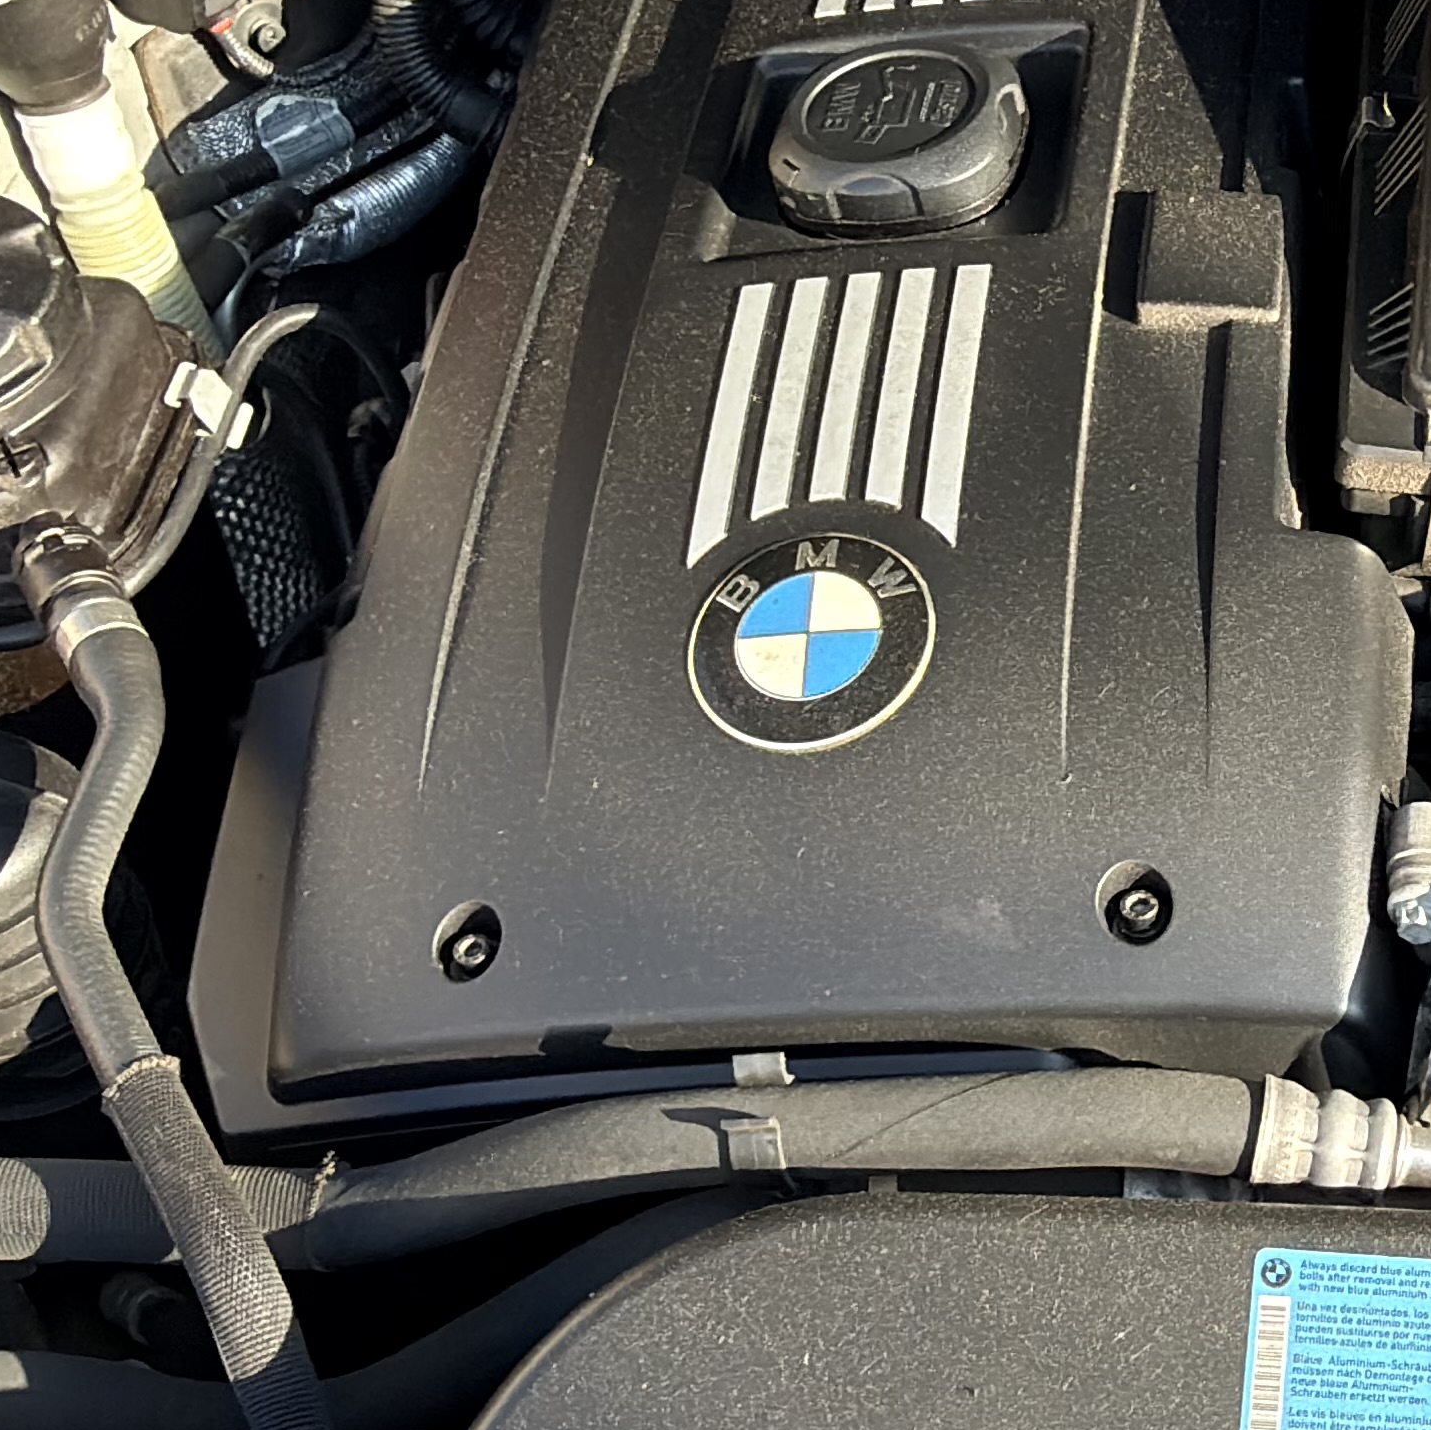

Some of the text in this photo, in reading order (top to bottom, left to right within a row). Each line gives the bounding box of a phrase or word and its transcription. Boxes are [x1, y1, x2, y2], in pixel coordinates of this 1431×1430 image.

[715, 538, 917, 613] BMW
[1300, 1259, 1337, 1274] Always
[1340, 1263, 1377, 1274] discard
[1380, 1265, 1401, 1276] blue
[1300, 1271, 1324, 1281] bolts
[1328, 1273, 1350, 1282] after
[1354, 1276, 1395, 1285] removal
[1398, 1279, 1417, 1288] and
[1299, 1283, 1320, 1292] with
[1348, 1285, 1369, 1295] blue
[1372, 1287, 1427, 1299] aluminium
[1341, 1316, 1353, 1325] de
[1356, 1317, 1401, 1327] aluminio
[1295, 1325, 1333, 1337] pueden
[1393, 1331, 1410, 1342] por
[1376, 1340, 1388, 1349] de
[1337, 1369, 1361, 1378] nach
[1365, 1369, 1424, 1385] Demontage
[1290, 1387, 1347, 1400] Schrauben
[1312, 1409, 1326, 1419] vis
[1288, 1419, 1326, 1430] doivent
